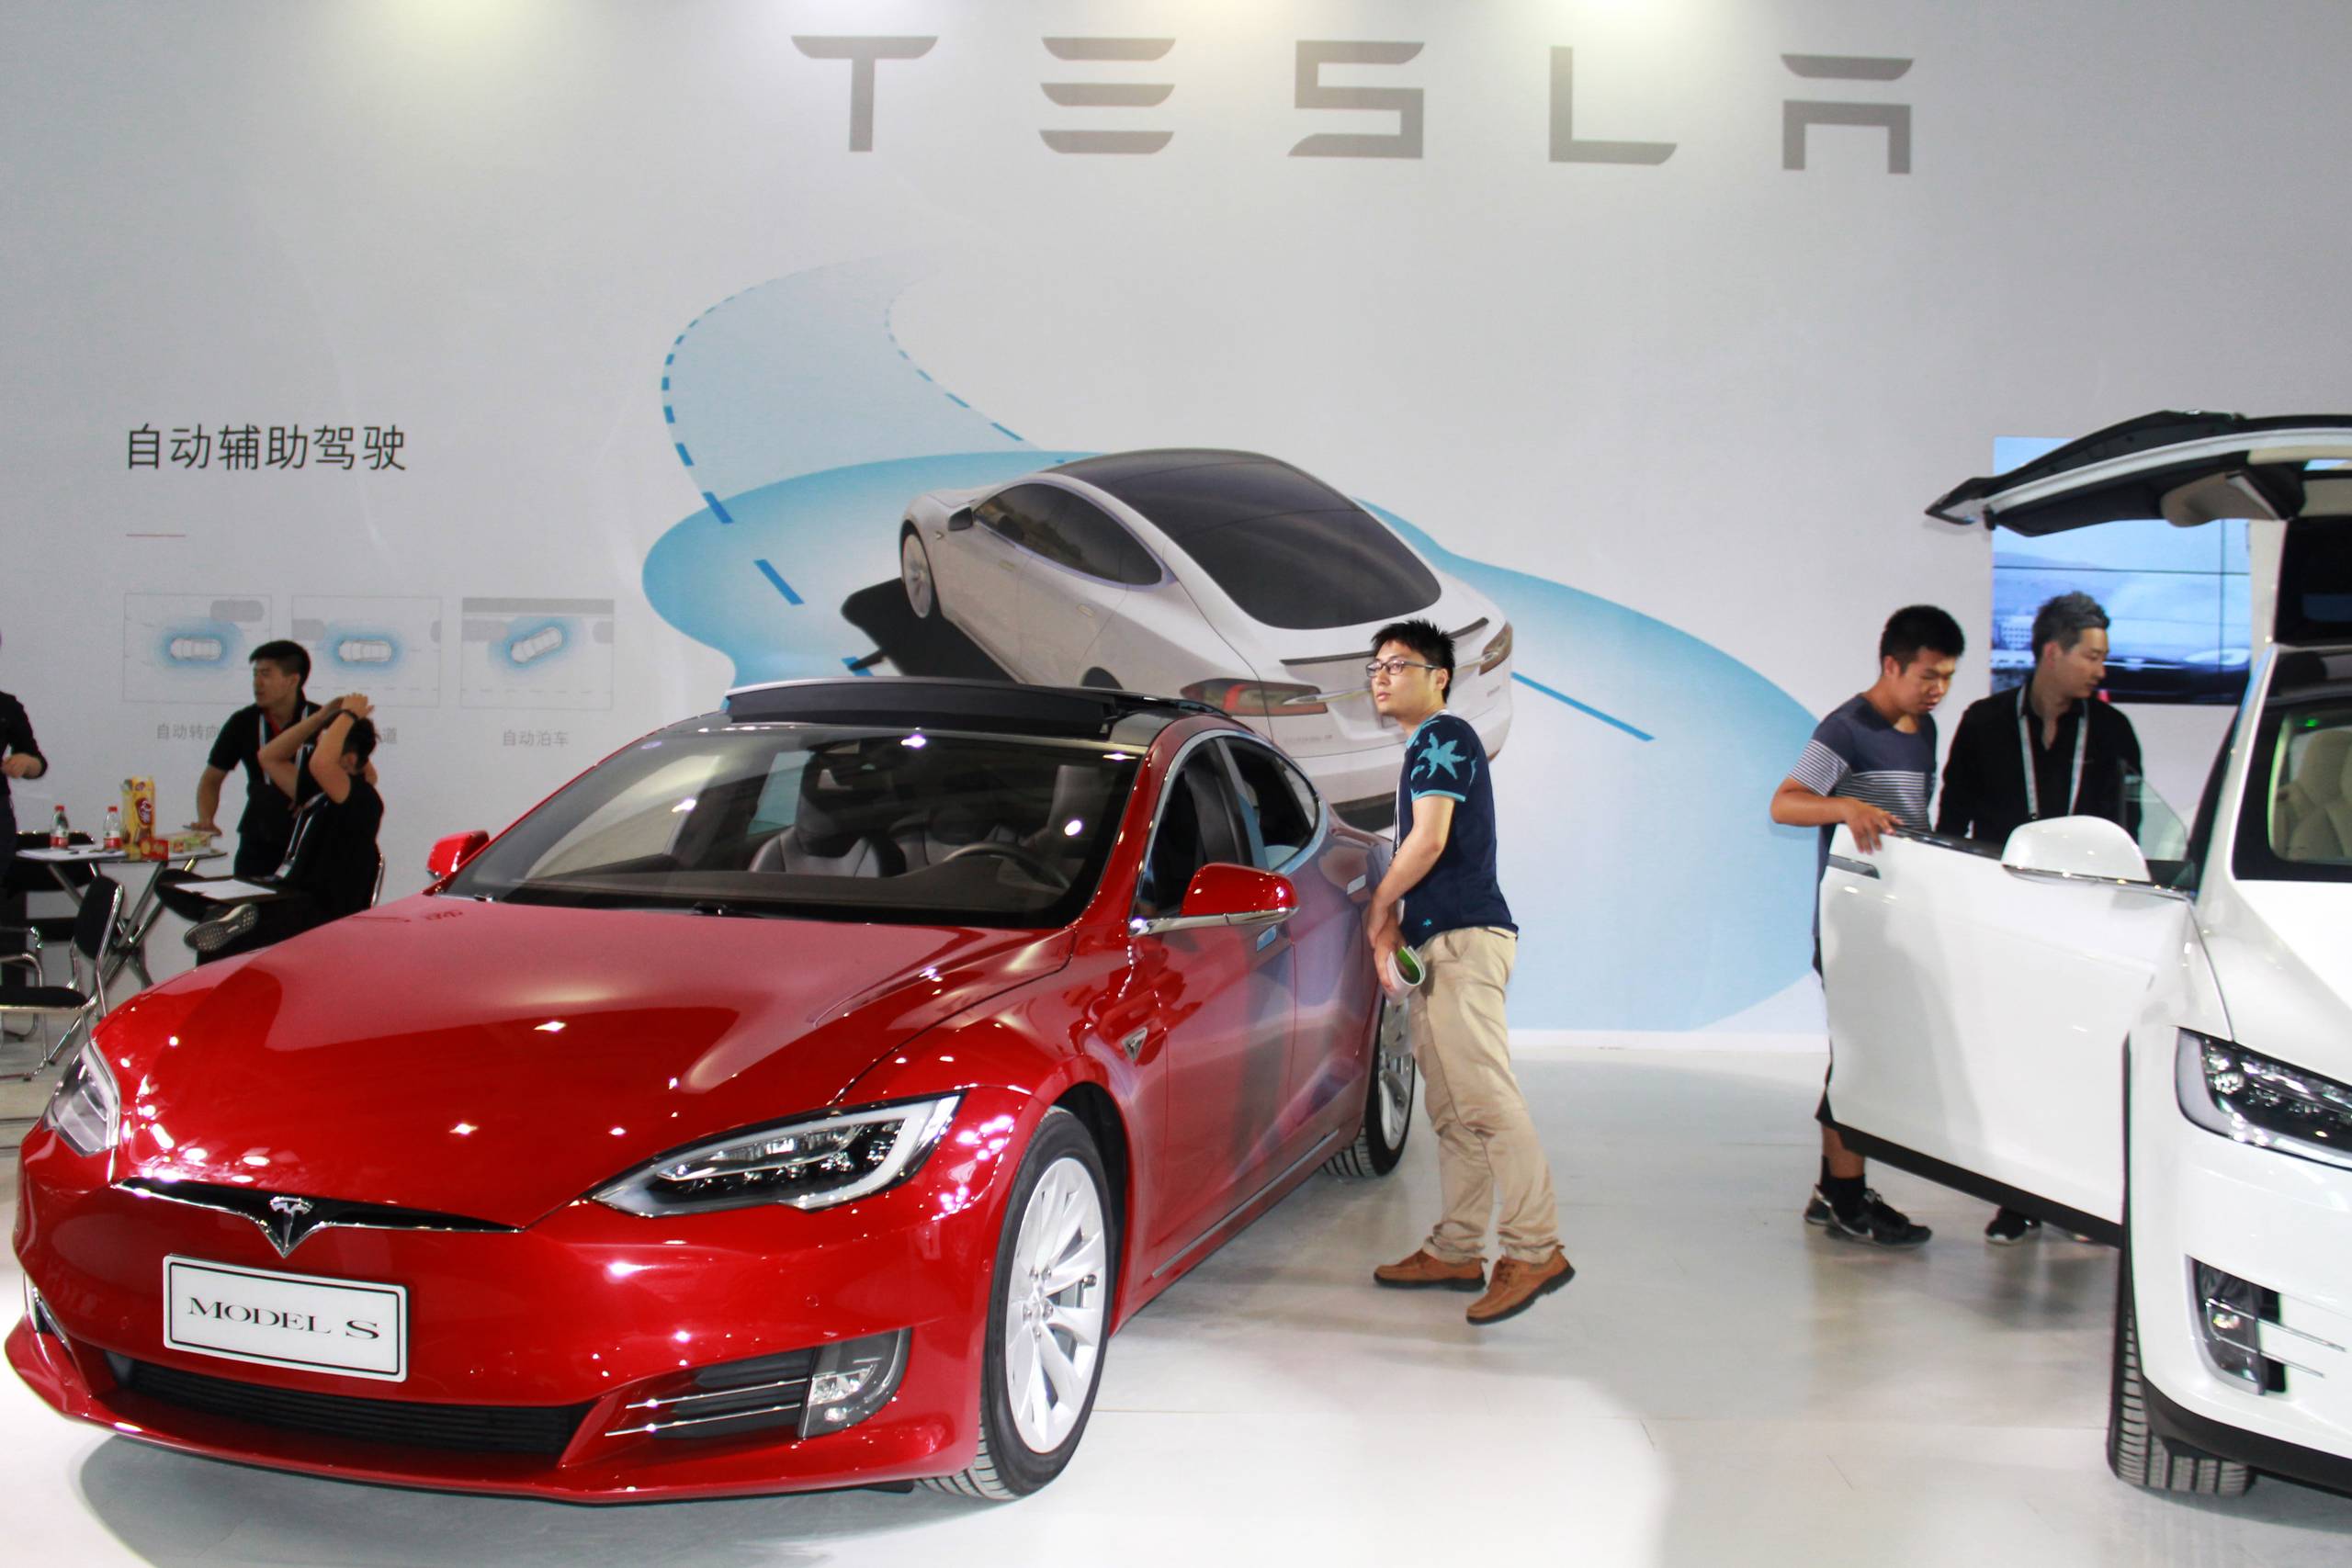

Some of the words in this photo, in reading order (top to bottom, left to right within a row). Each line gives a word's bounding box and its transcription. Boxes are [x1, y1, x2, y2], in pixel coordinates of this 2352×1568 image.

[790, 35, 1916, 175] TESLA
[128, 423, 406, 470] 自动辅助驾驶
[503, 729, 569, 748] 自动泊车
[188, 1297, 331, 1335] MODEL
[345, 1320, 379, 1340] S
